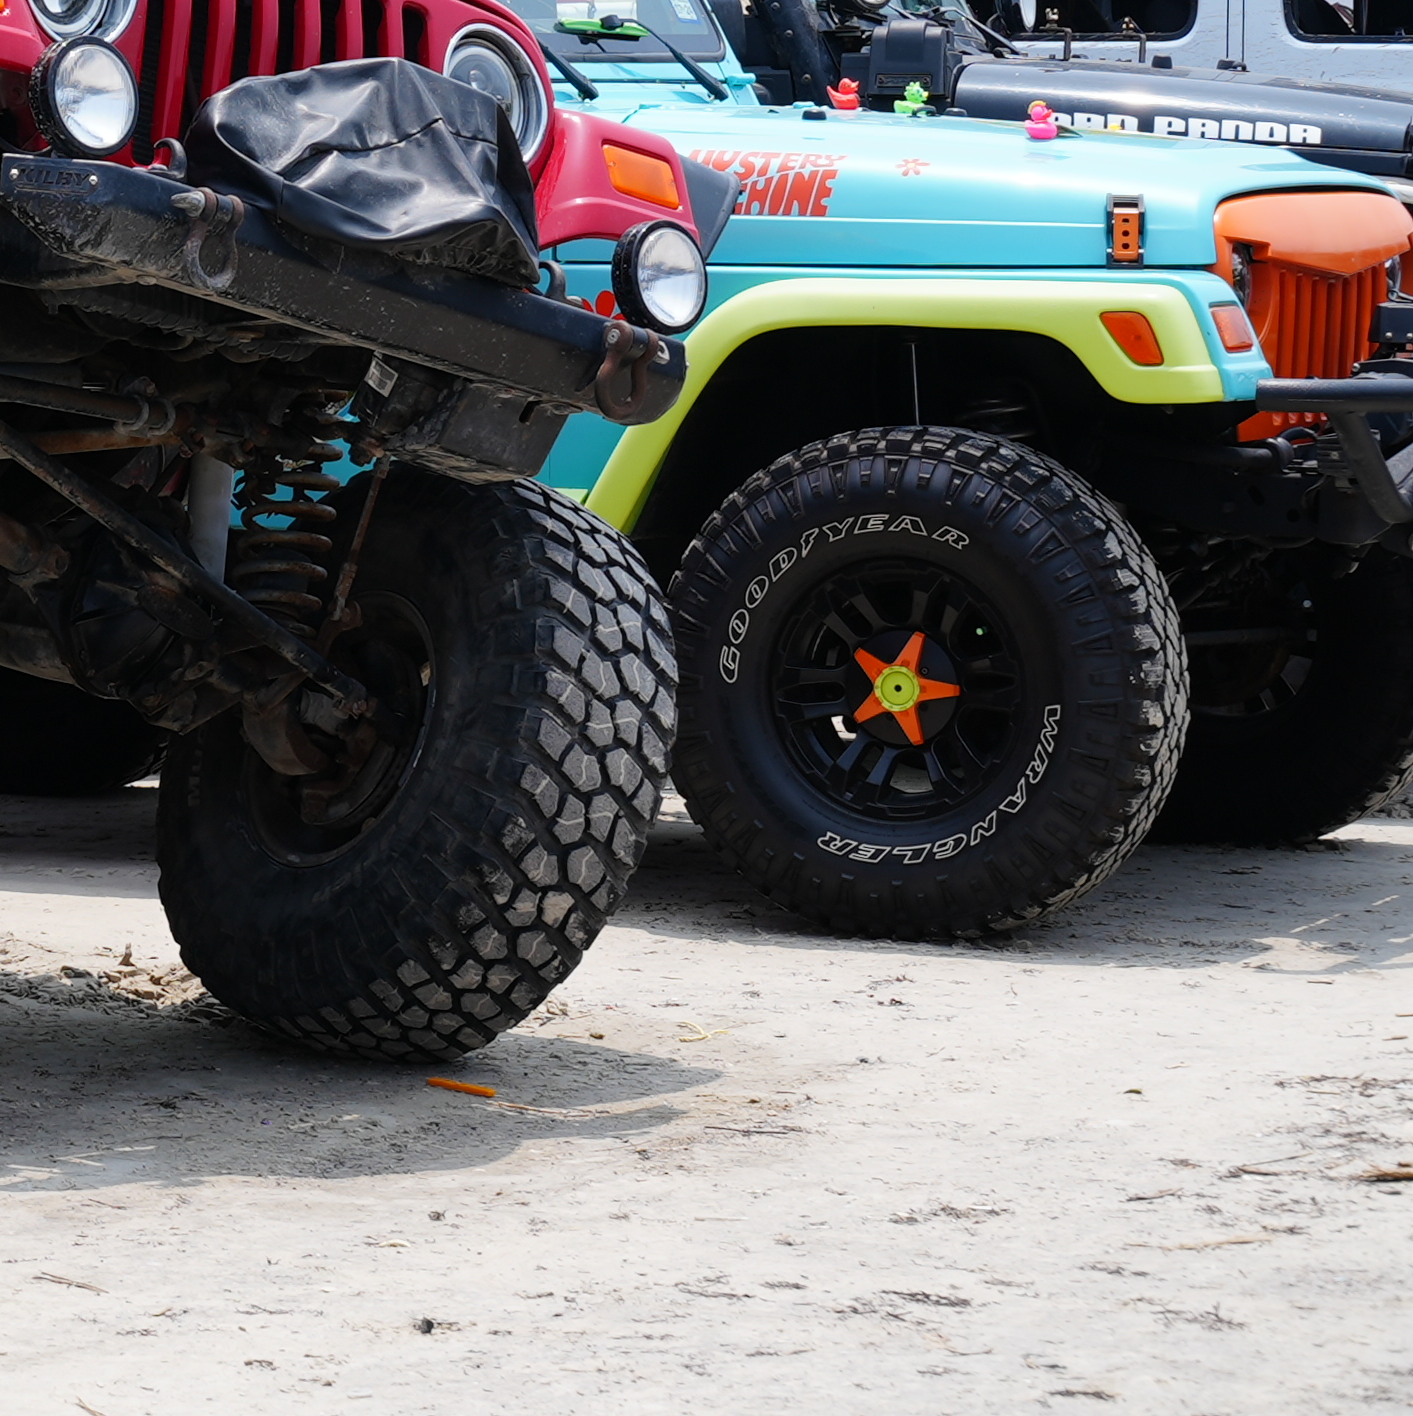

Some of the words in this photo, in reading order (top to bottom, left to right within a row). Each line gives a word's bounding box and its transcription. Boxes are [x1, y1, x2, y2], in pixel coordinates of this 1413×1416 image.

[1154, 115, 1322, 145] PANDA
[719, 514, 970, 683] GOODYEAR
[818, 705, 1061, 864] WRANGLER
